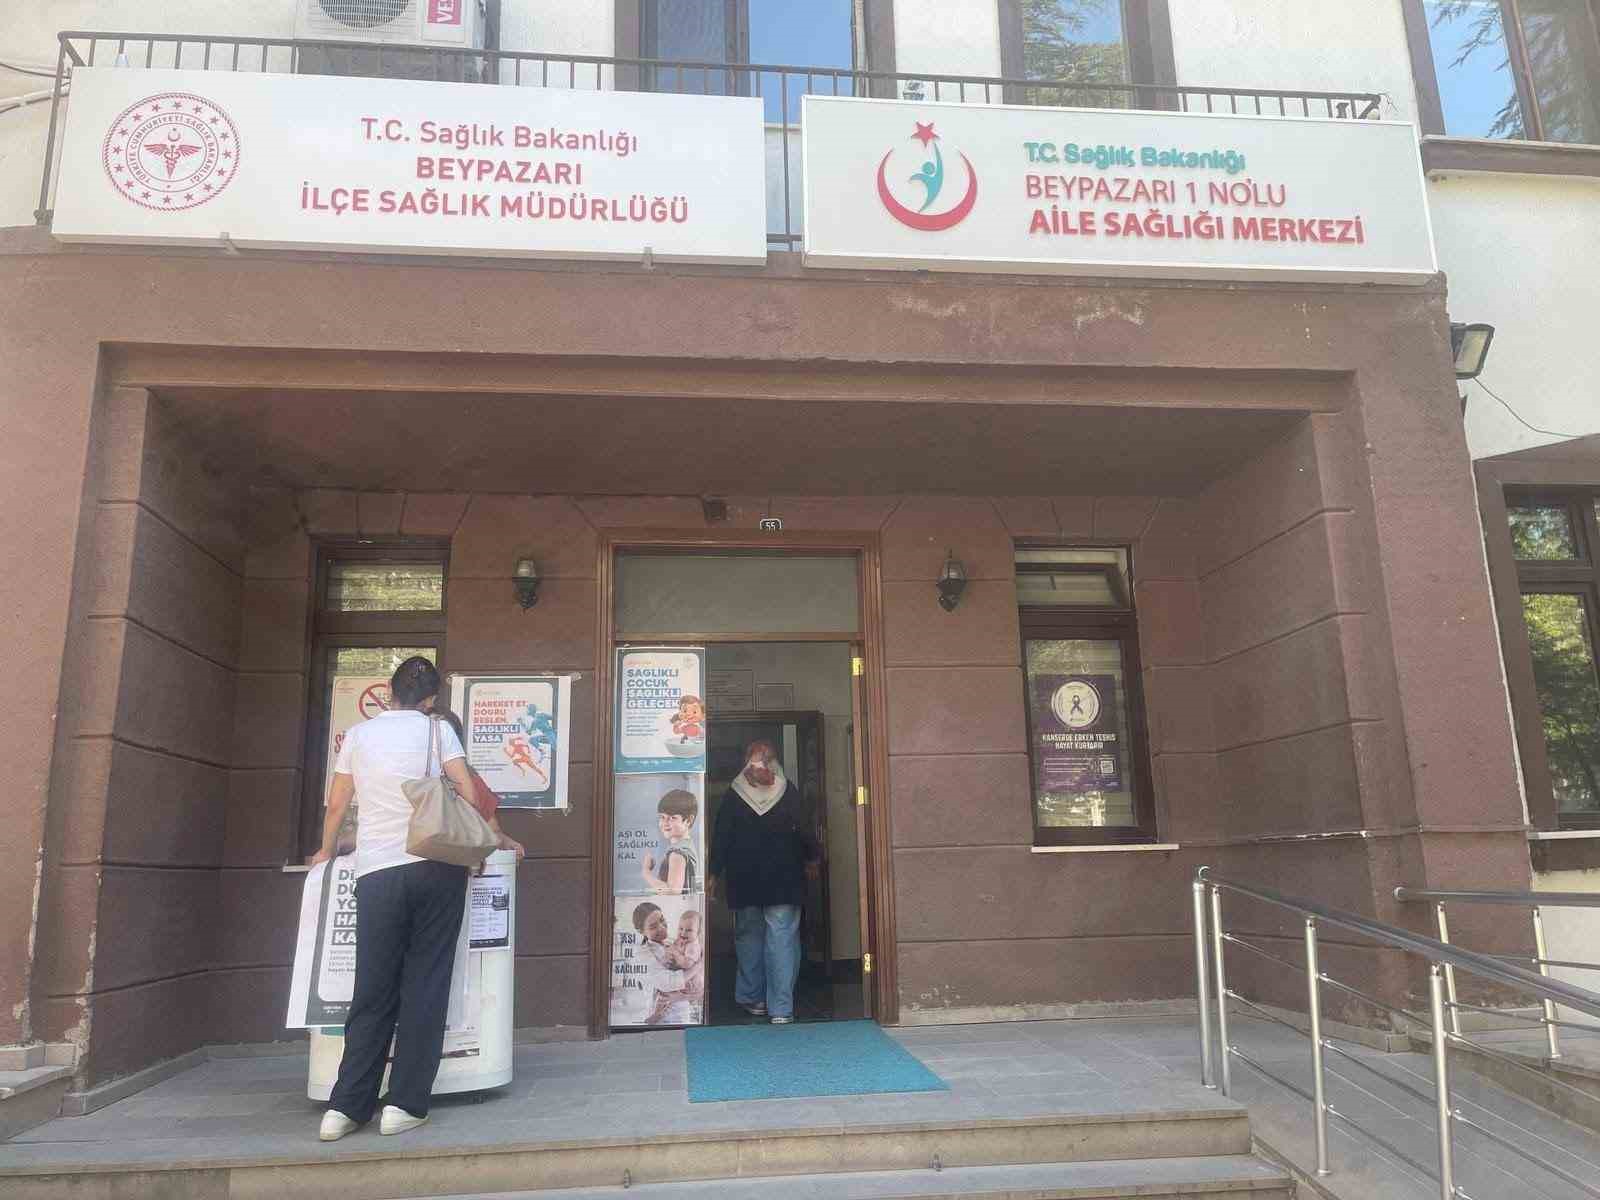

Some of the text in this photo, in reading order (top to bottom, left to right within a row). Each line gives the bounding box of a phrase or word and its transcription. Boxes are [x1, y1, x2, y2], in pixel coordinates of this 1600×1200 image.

[361, 117, 638, 157] T.C. Sağlık Bakanlığı
[416, 156, 583, 185] BEYPAZARI
[1023, 141, 1246, 174] T.C. Sağlık Bakanlığı
[302, 181, 689, 223] İLÇE SAĞLIK MÜDÜRLÜĞÜ
[1025, 174, 1176, 204] BEYPAZARI
[1185, 181, 1198, 204] 1
[1029, 204, 1365, 245] AİLE SAĞLIĞI MERKEZİ
